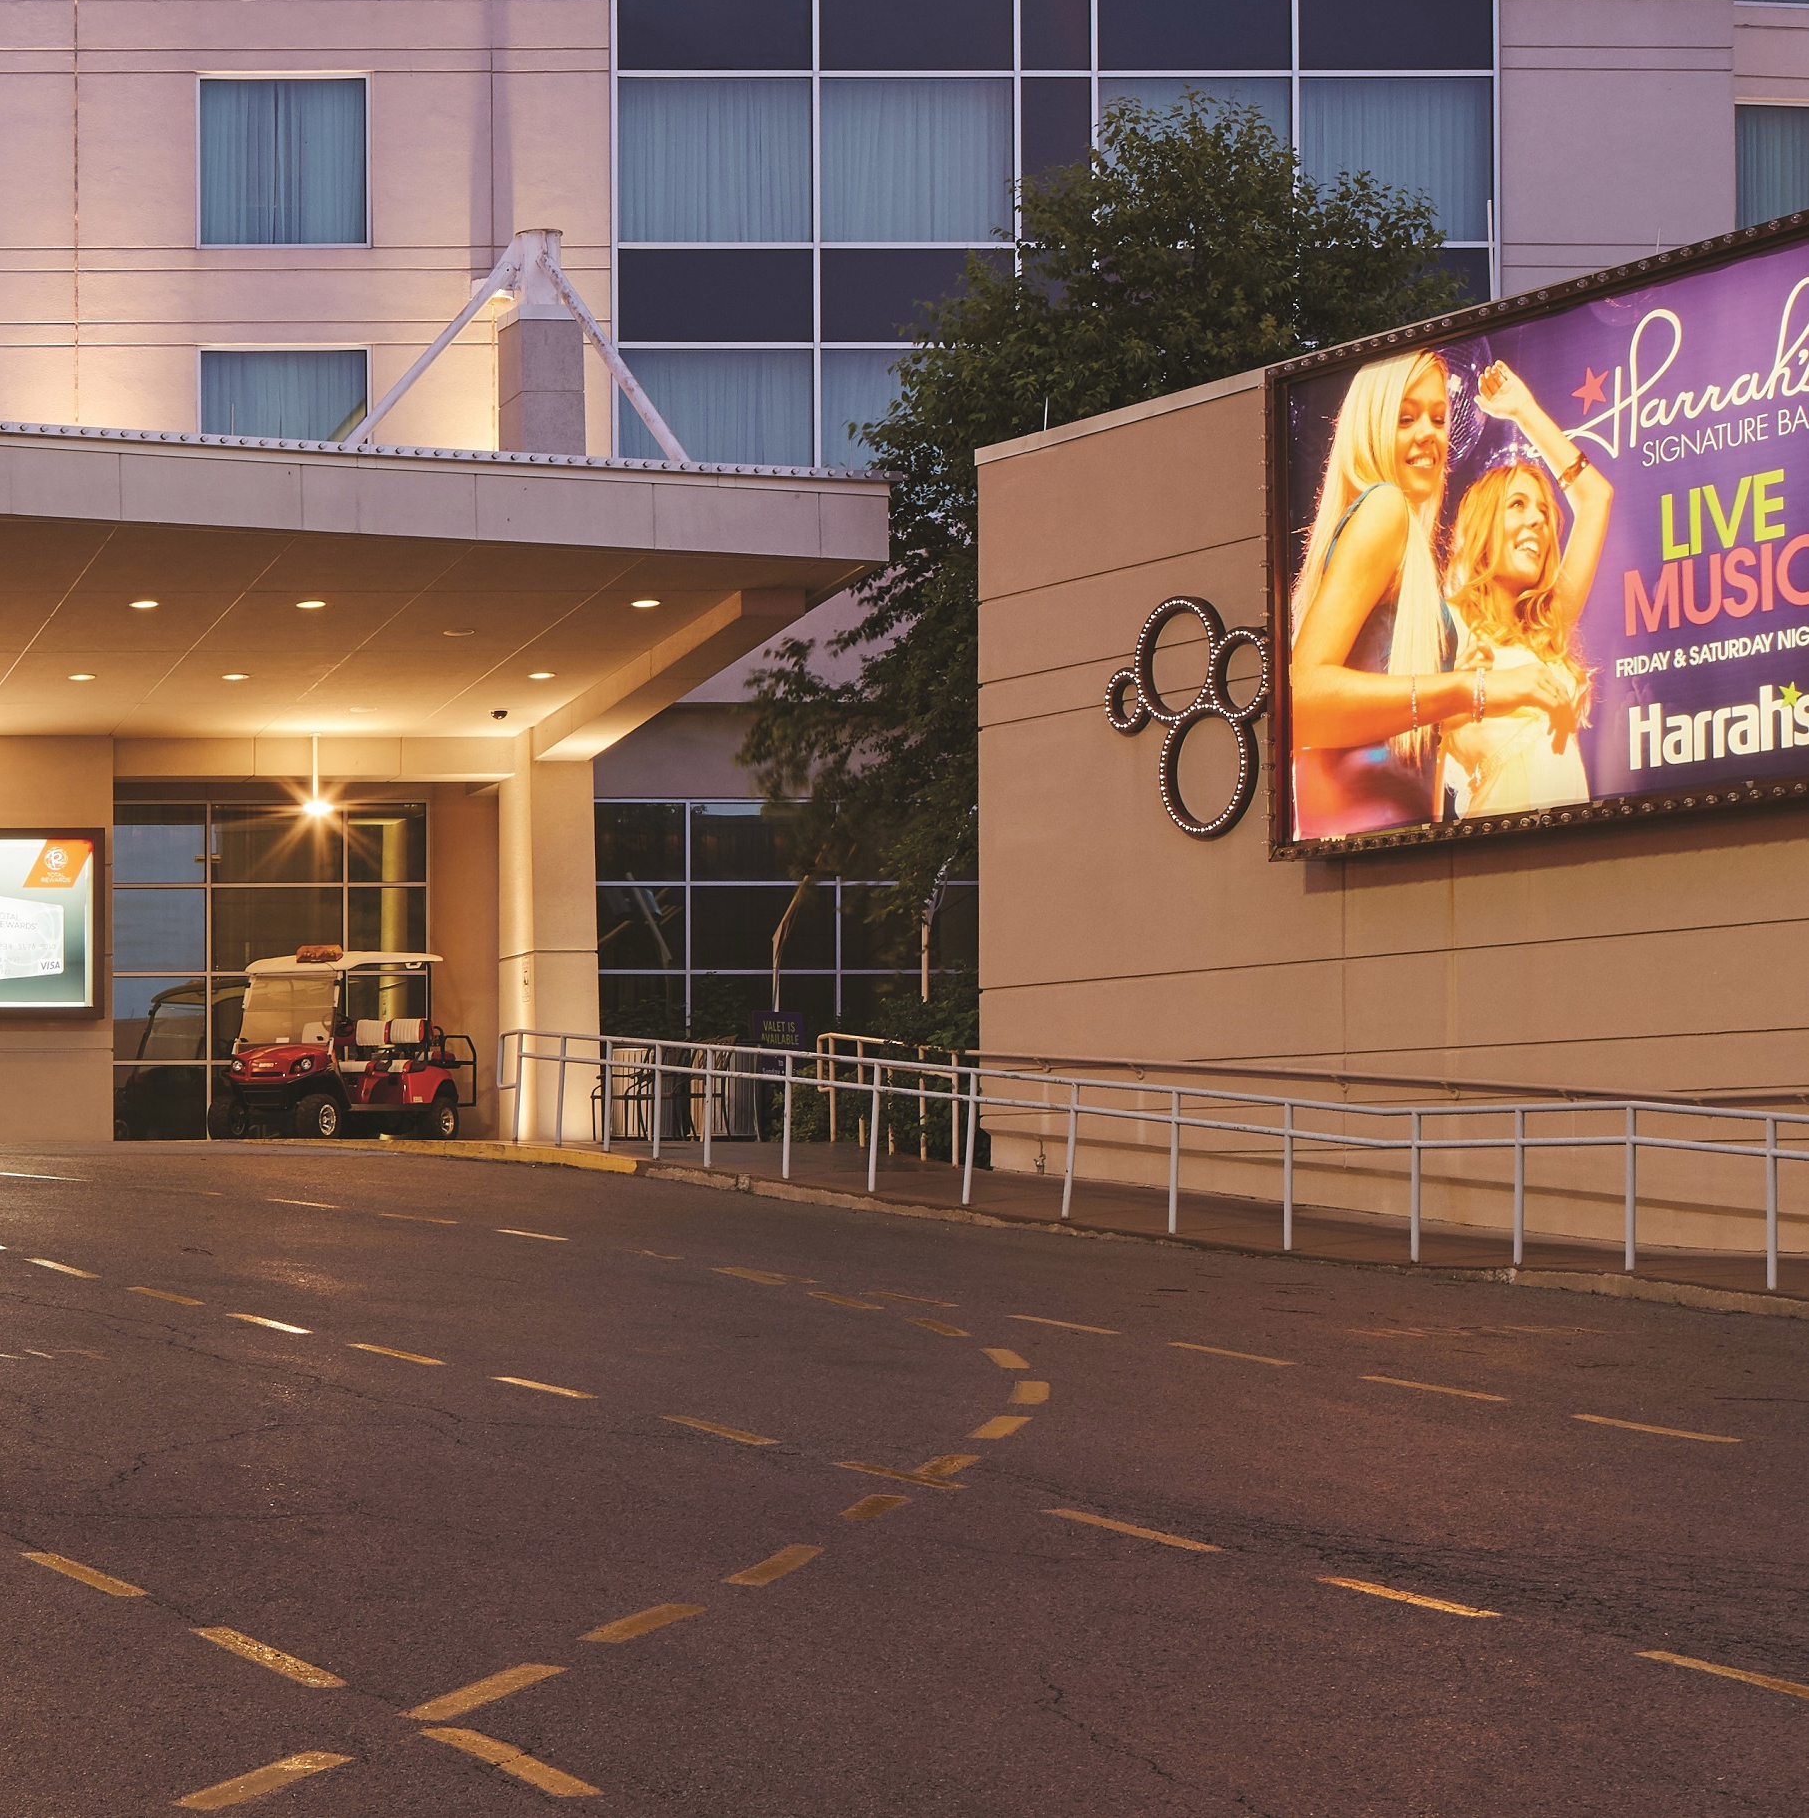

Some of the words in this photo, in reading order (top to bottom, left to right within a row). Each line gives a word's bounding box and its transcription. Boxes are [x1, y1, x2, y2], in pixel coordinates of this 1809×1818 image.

[1642, 413, 1769, 467] SIGNATURE
[1660, 468, 1785, 561] LIVE
[1623, 534, 1809, 637] MUSIC
[1616, 650, 1671, 678] FRIDAY
[1673, 648, 1687, 668] &
[1689, 632, 1774, 666] SATURDAY
[40, 961, 60, 970] VISA
[761, 1032, 799, 1045] AVAILABLE
[763, 1020, 785, 1032] VALET
[787, 1021, 796, 1033] IS
